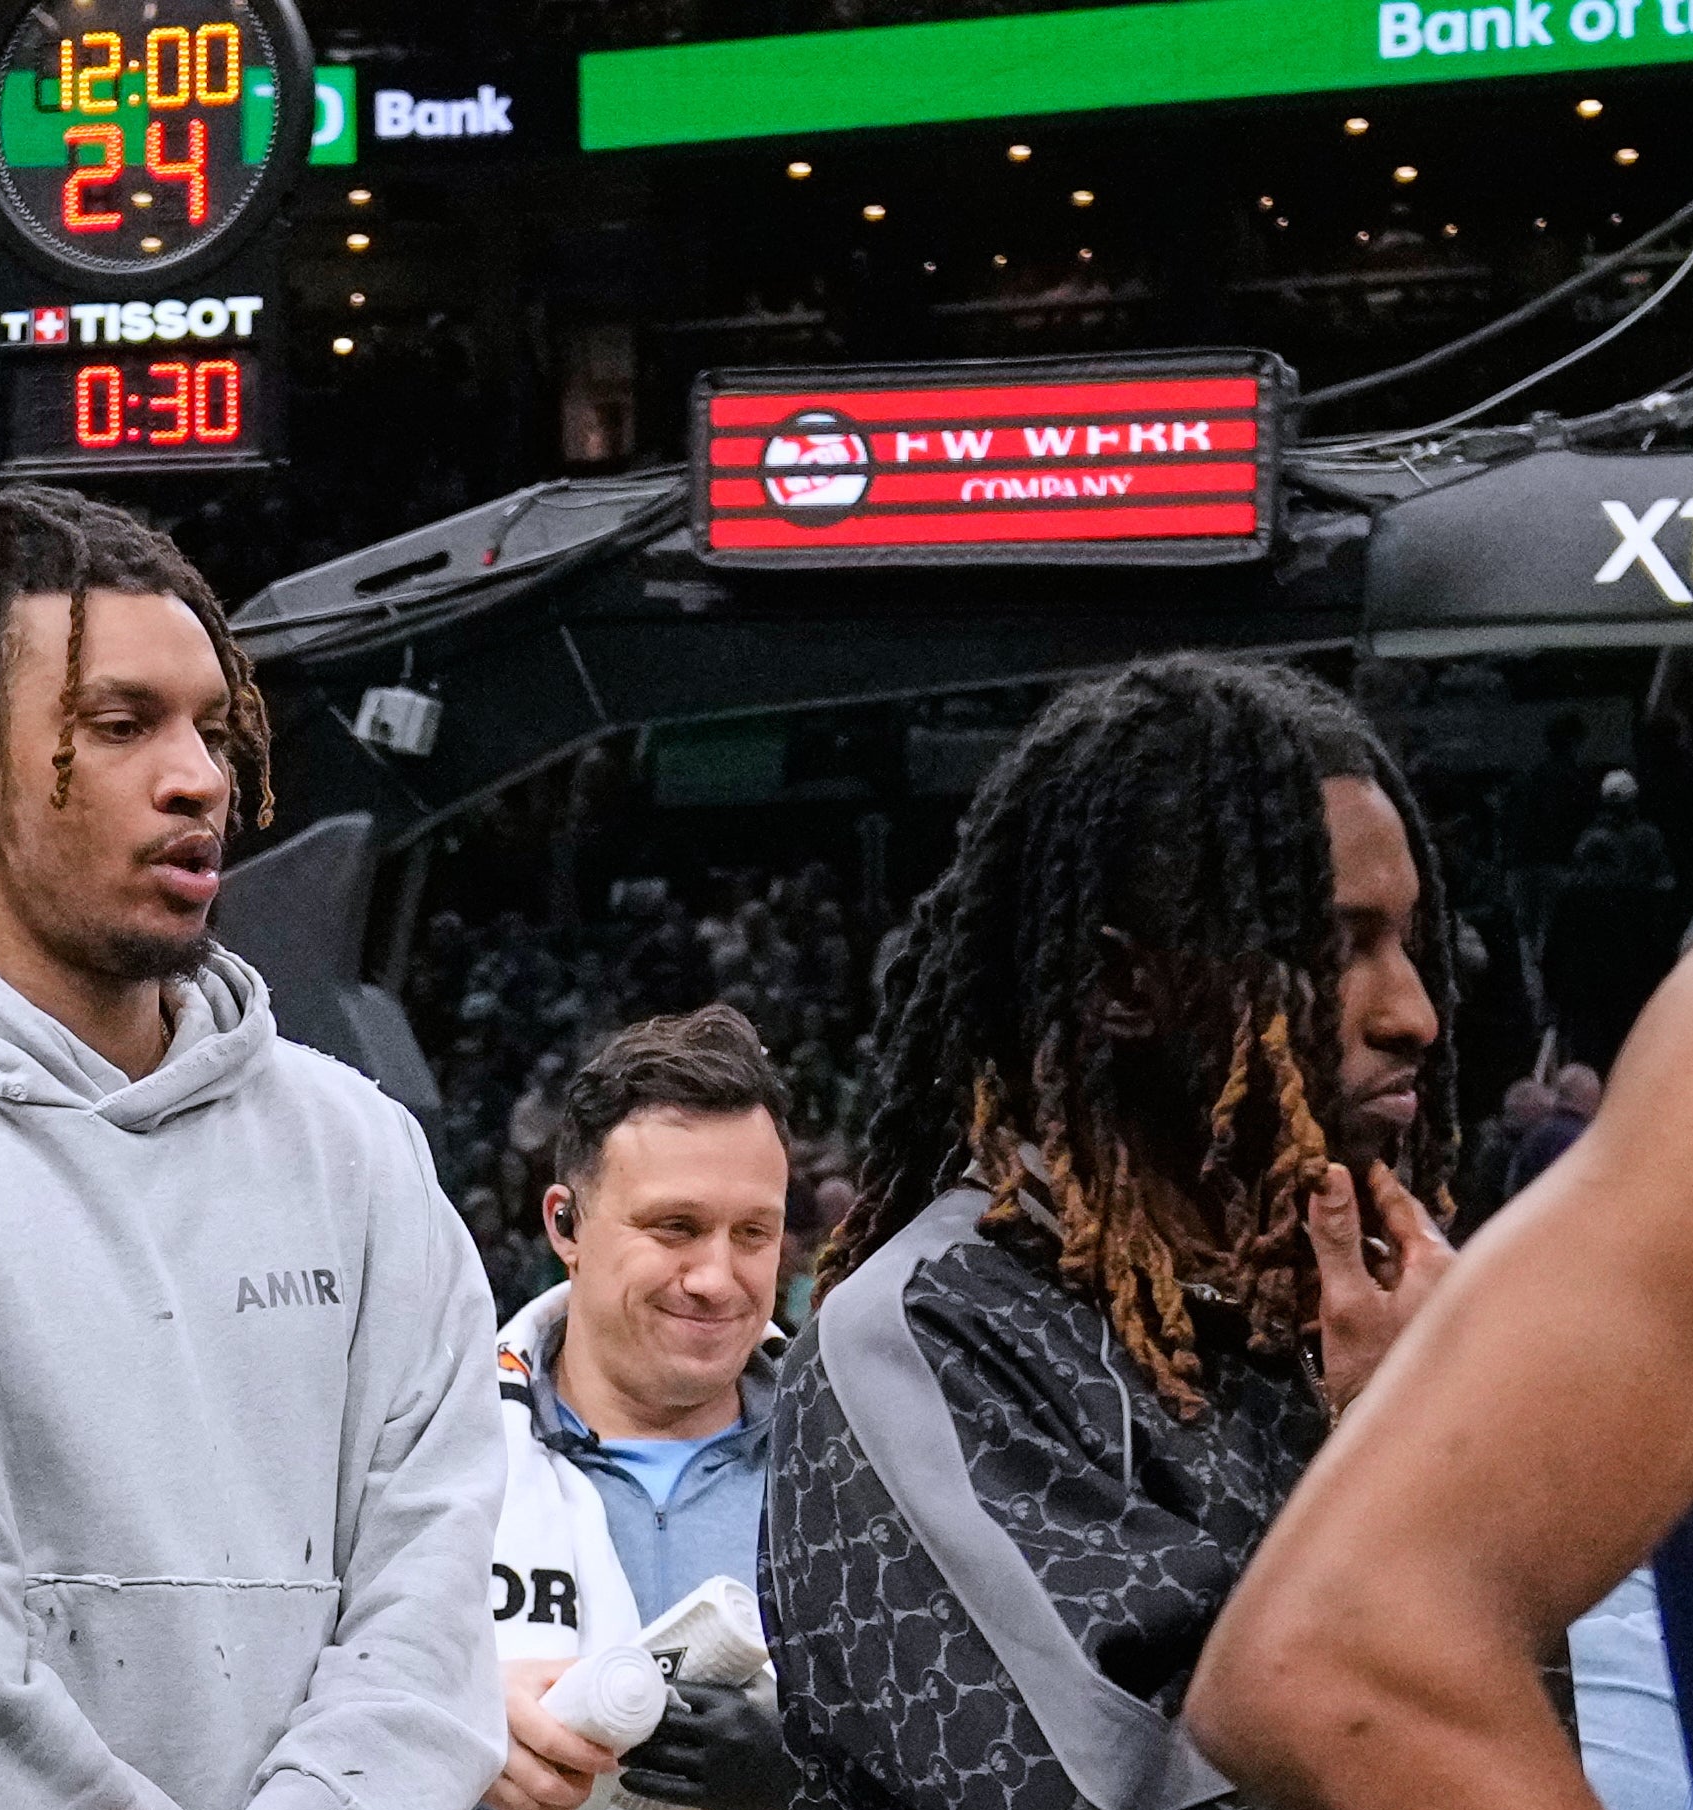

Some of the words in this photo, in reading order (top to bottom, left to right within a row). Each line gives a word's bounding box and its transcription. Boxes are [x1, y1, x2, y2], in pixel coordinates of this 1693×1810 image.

[1378, 0, 1554, 59] Bank
[60, 22, 240, 114] 12:00
[374, 84, 513, 138] Bank
[62, 118, 208, 233] 24
[70, 295, 264, 343] TISSOT
[75, 359, 242, 449] 0:30
[235, 1268, 345, 1314] AMIR
